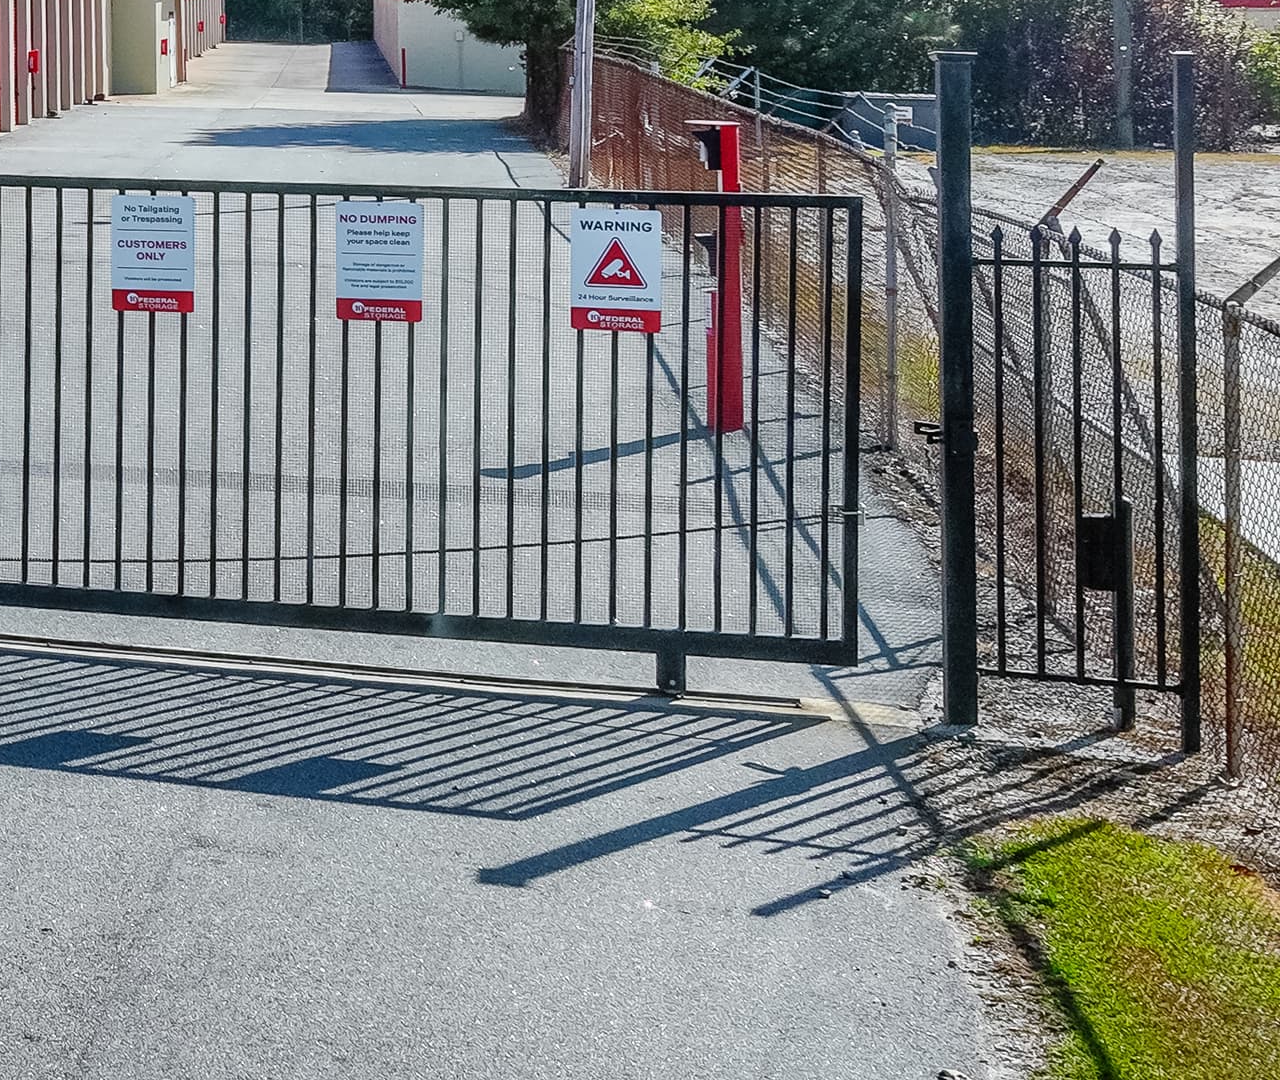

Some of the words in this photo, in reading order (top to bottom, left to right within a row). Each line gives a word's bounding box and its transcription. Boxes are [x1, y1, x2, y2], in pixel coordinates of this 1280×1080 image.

[138, 205, 180, 214] Tailgating
[132, 216, 183, 224] Trespassing
[340, 215, 357, 223] NO
[360, 215, 417, 224] DUMPING
[580, 220, 652, 232] WARNING
[373, 229, 390, 237] help
[117, 240, 187, 249] CUSTOMERS
[136, 252, 166, 260] ONLY
[600, 315, 644, 323] FEDERAL
[600, 321, 644, 329] STORAGE
